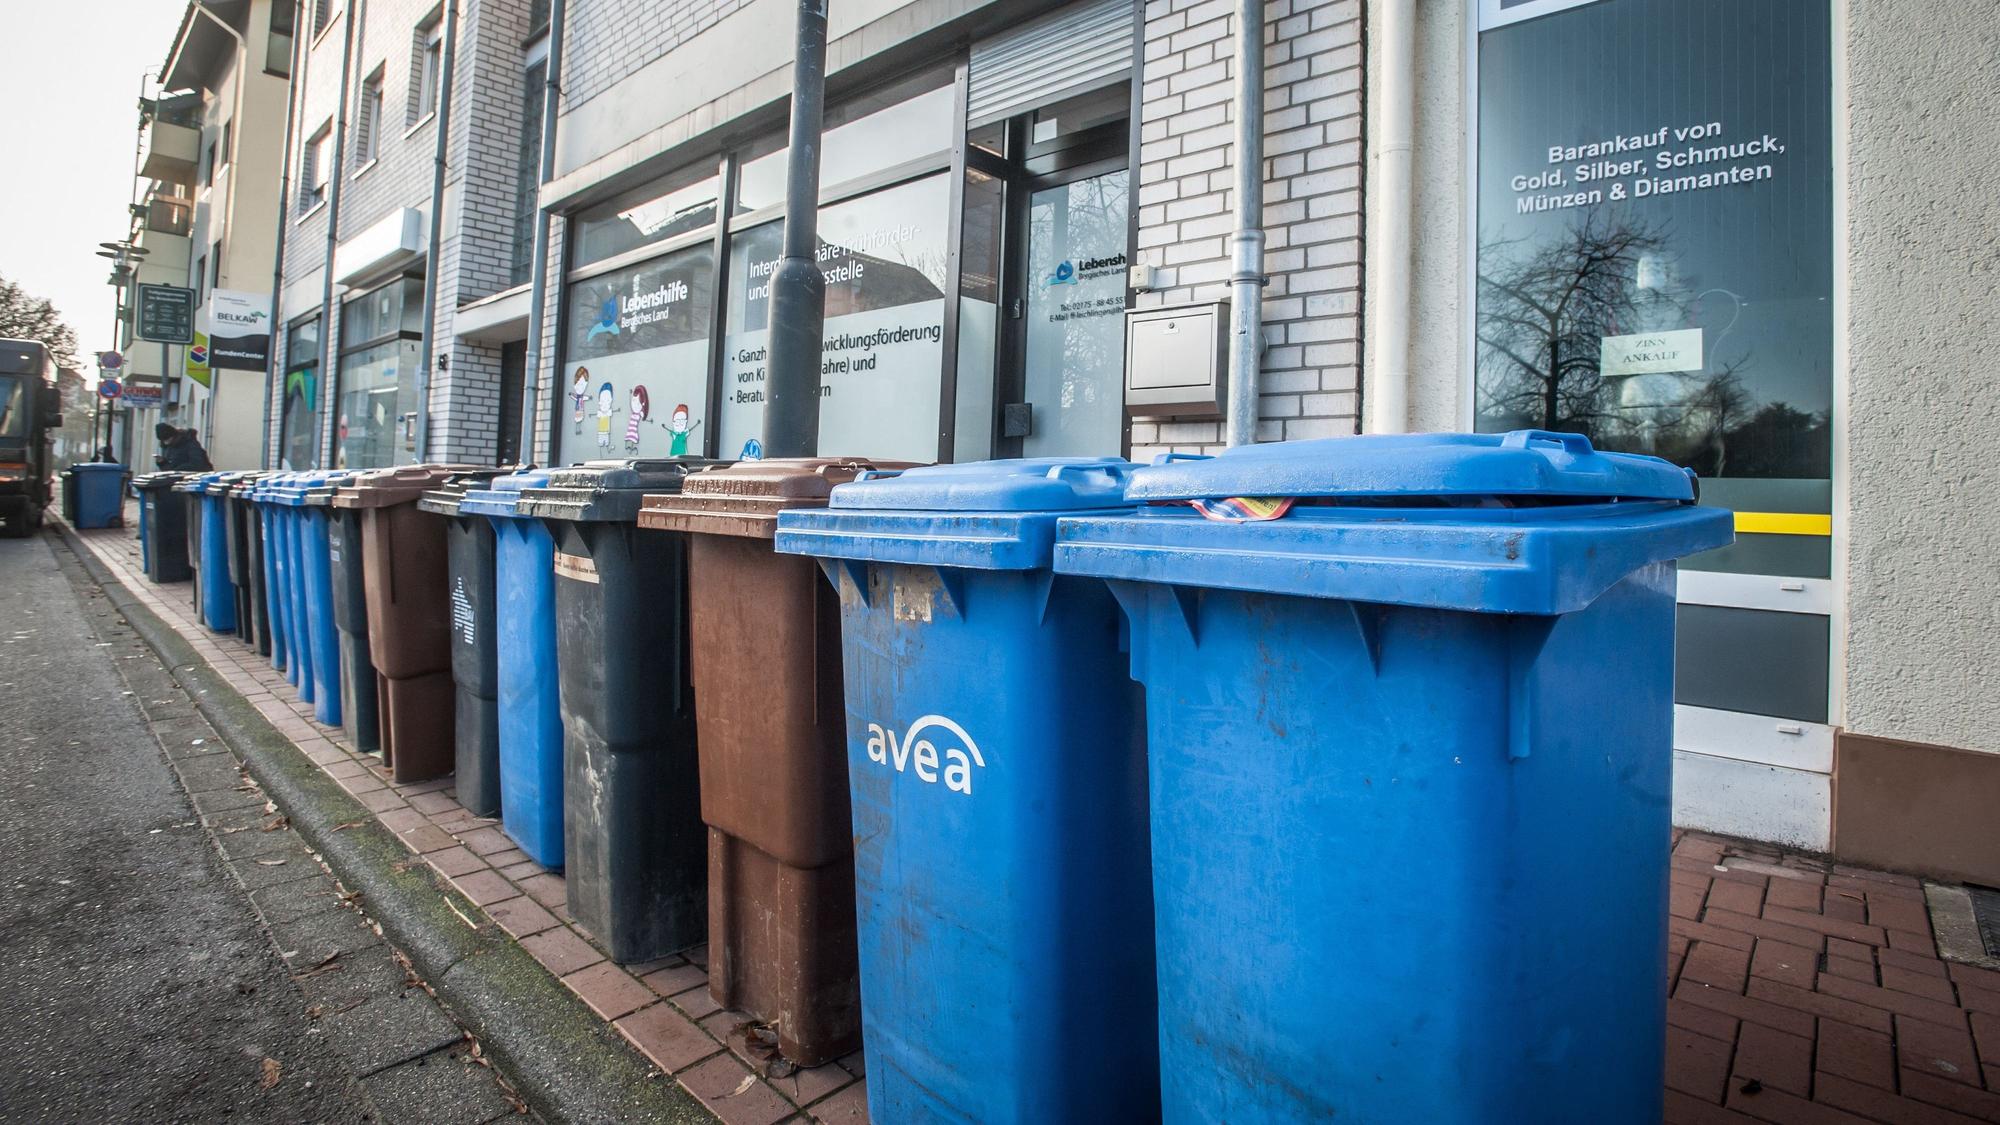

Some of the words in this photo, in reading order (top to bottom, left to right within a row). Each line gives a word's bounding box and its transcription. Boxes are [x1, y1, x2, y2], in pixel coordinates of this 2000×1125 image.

[1548, 127, 1668, 163] Barankauf
[1674, 121, 1721, 142] von
[1511, 169, 1568, 192] Gold,
[1575, 159, 1648, 182] Silber,
[1655, 135, 1785, 169] Schmuck,
[1516, 190, 1602, 214] Münzen
[1609, 183, 1628, 201] &
[1634, 164, 1772, 197] Diamanten
[822, 261, 864, 285] sstelle
[622, 280, 688, 314] Lebenshilfe
[217, 312, 258, 324] BELKAW
[621, 311, 652, 329] Bergisches
[652, 306, 669, 322] Land
[738, 346, 767, 363] Ganzh
[821, 325, 941, 352] wicklungsförderung
[1623, 352, 1680, 363] ANKAUF
[1635, 339, 1666, 348] ZINN
[738, 371, 754, 383] von
[822, 357, 850, 375] ahre)
[853, 353, 876, 371] und
[736, 390, 765, 404] Beratu
[867, 714, 985, 795] avea
